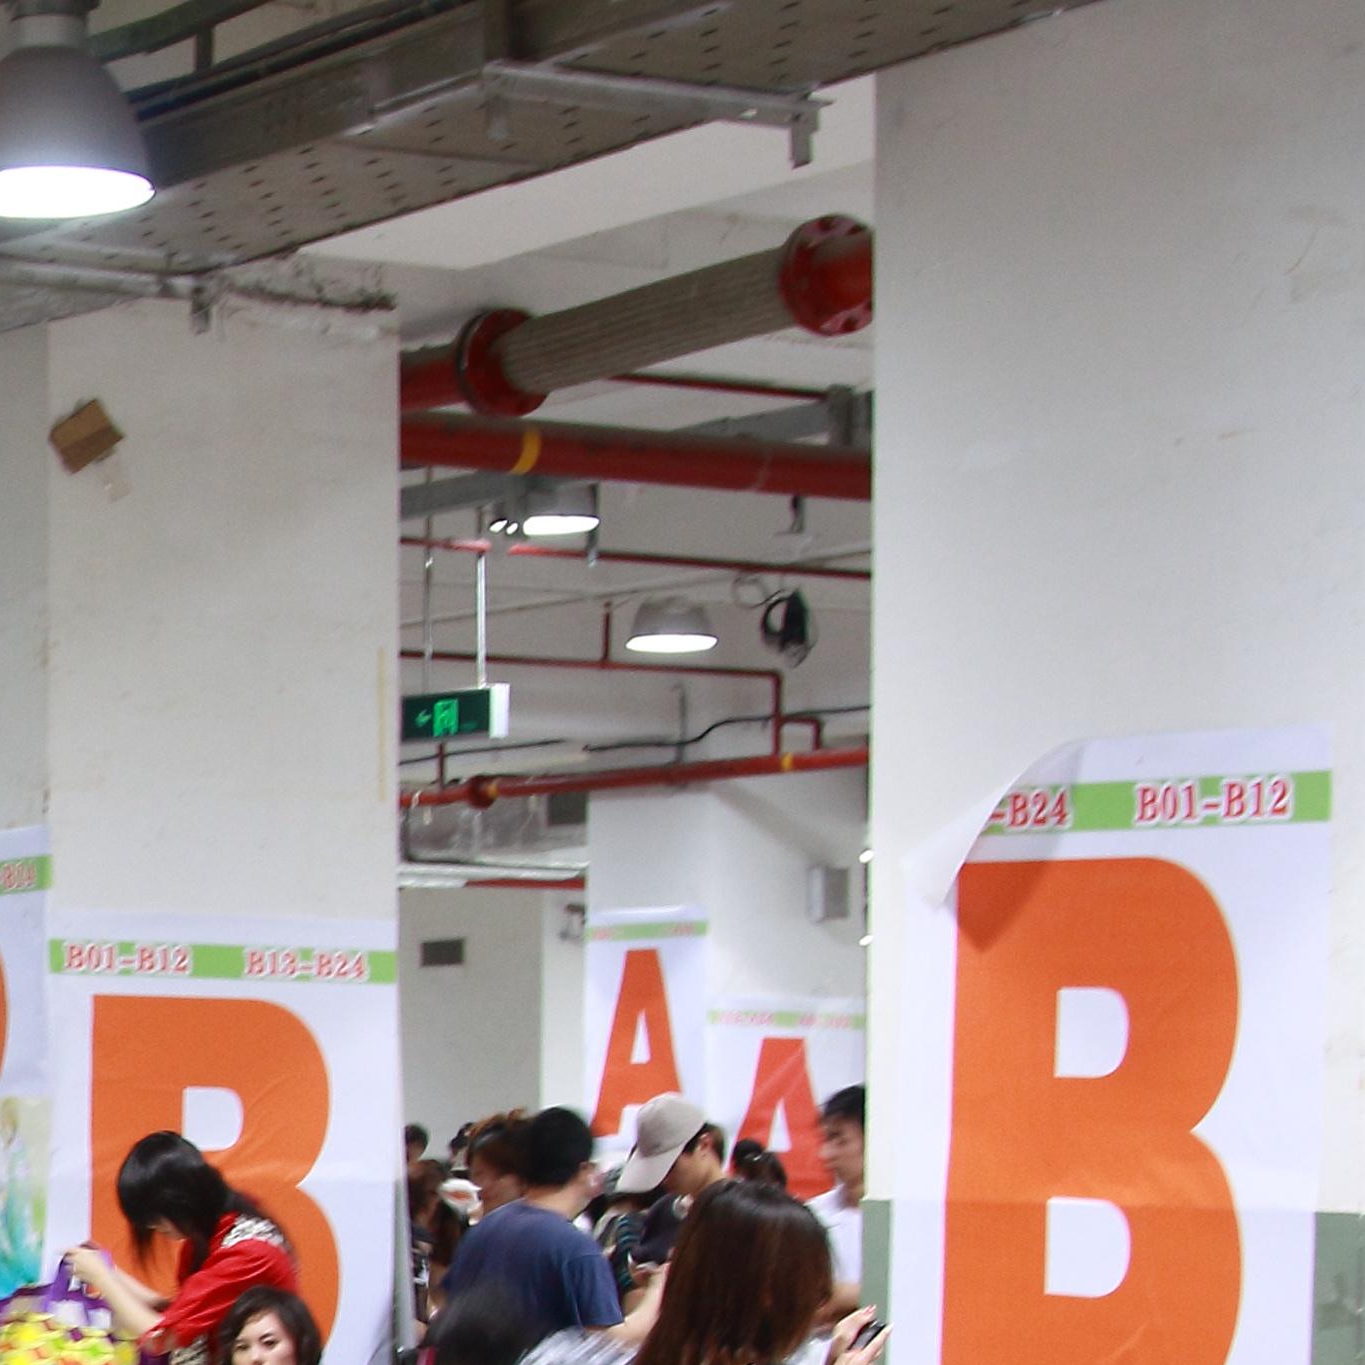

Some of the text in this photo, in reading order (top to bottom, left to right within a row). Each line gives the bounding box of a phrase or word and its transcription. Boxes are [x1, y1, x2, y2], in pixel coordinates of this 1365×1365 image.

[989, 778, 1289, 828] -B24 B01-B12
[64, 943, 367, 980] B01-B12 B13-B24
[591, 947, 681, 1136] A
[91, 994, 339, 1348] B
[728, 1037, 835, 1200] A
